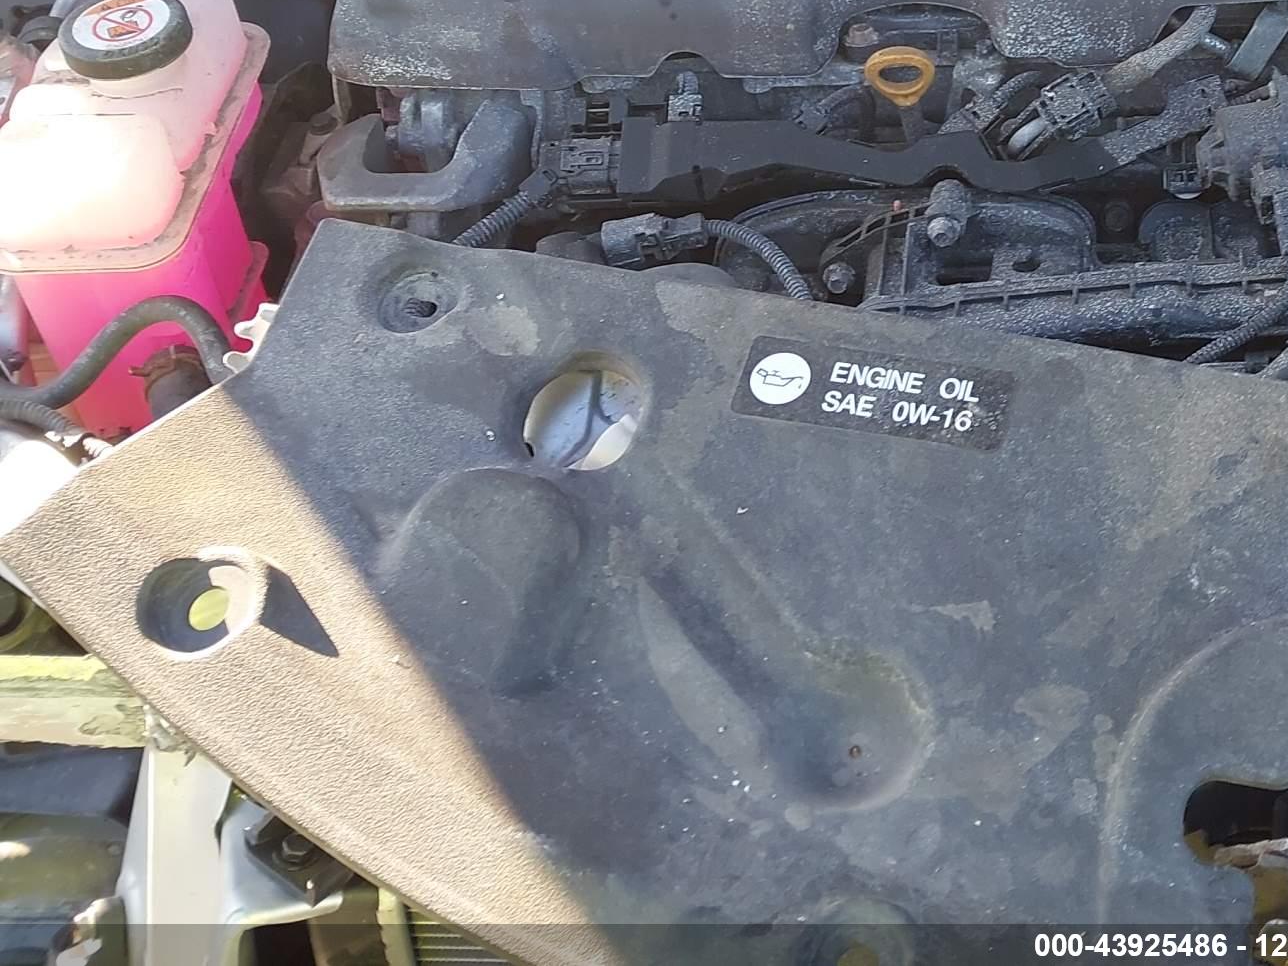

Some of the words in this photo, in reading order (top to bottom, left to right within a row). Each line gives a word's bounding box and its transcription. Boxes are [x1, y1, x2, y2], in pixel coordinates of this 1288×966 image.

[830, 362, 925, 394] ENGINE
[939, 377, 979, 402] OIL
[821, 390, 877, 417] SAE
[892, 401, 973, 431] 0W-16
